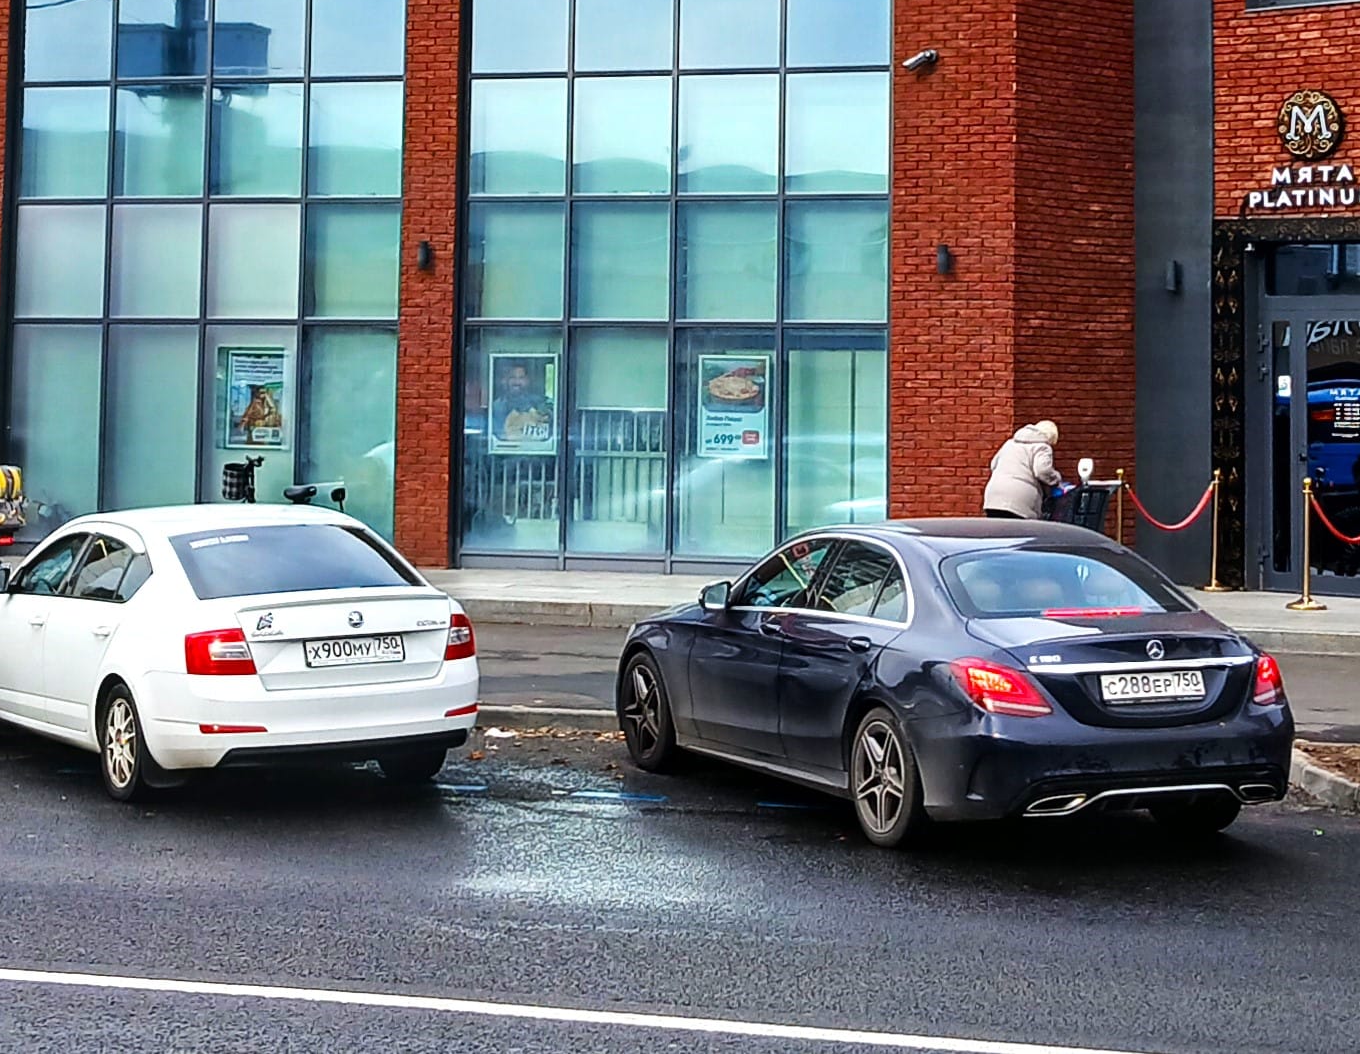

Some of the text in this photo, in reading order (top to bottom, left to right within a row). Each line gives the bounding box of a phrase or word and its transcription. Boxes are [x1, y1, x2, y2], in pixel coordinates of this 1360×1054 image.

[1271, 163, 1354, 186] МЯТА
[713, 433, 735, 445] 699
[311, 640, 372, 660] Х900МУ
[1107, 676, 1172, 696] С288ЕР
